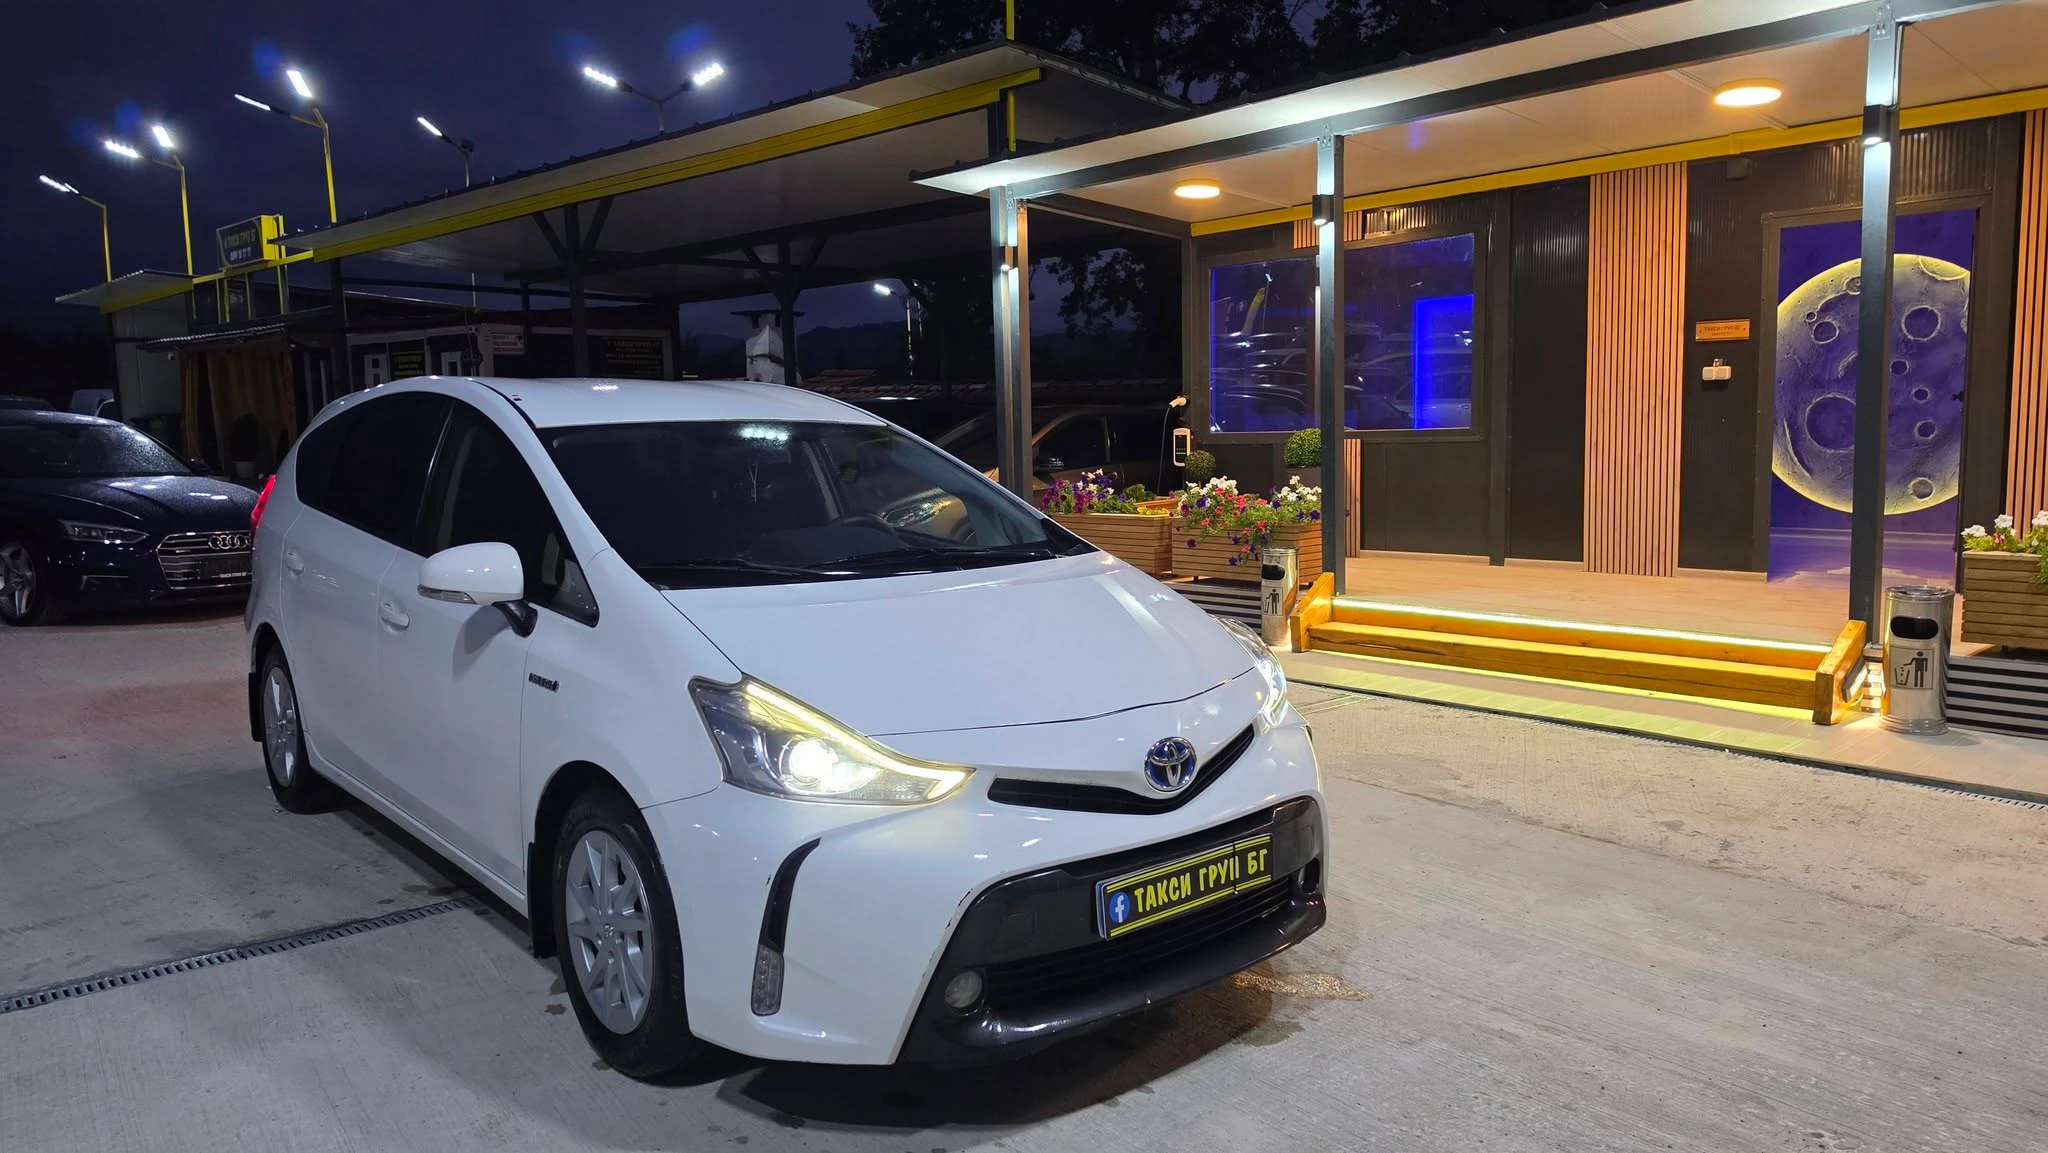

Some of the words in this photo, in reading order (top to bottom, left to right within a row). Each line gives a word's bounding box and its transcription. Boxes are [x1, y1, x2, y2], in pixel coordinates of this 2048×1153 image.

[1134, 872, 1192, 913] ТАКСИ
[1199, 855, 1240, 892] ГРУП
[1247, 848, 1268, 875] БГ
